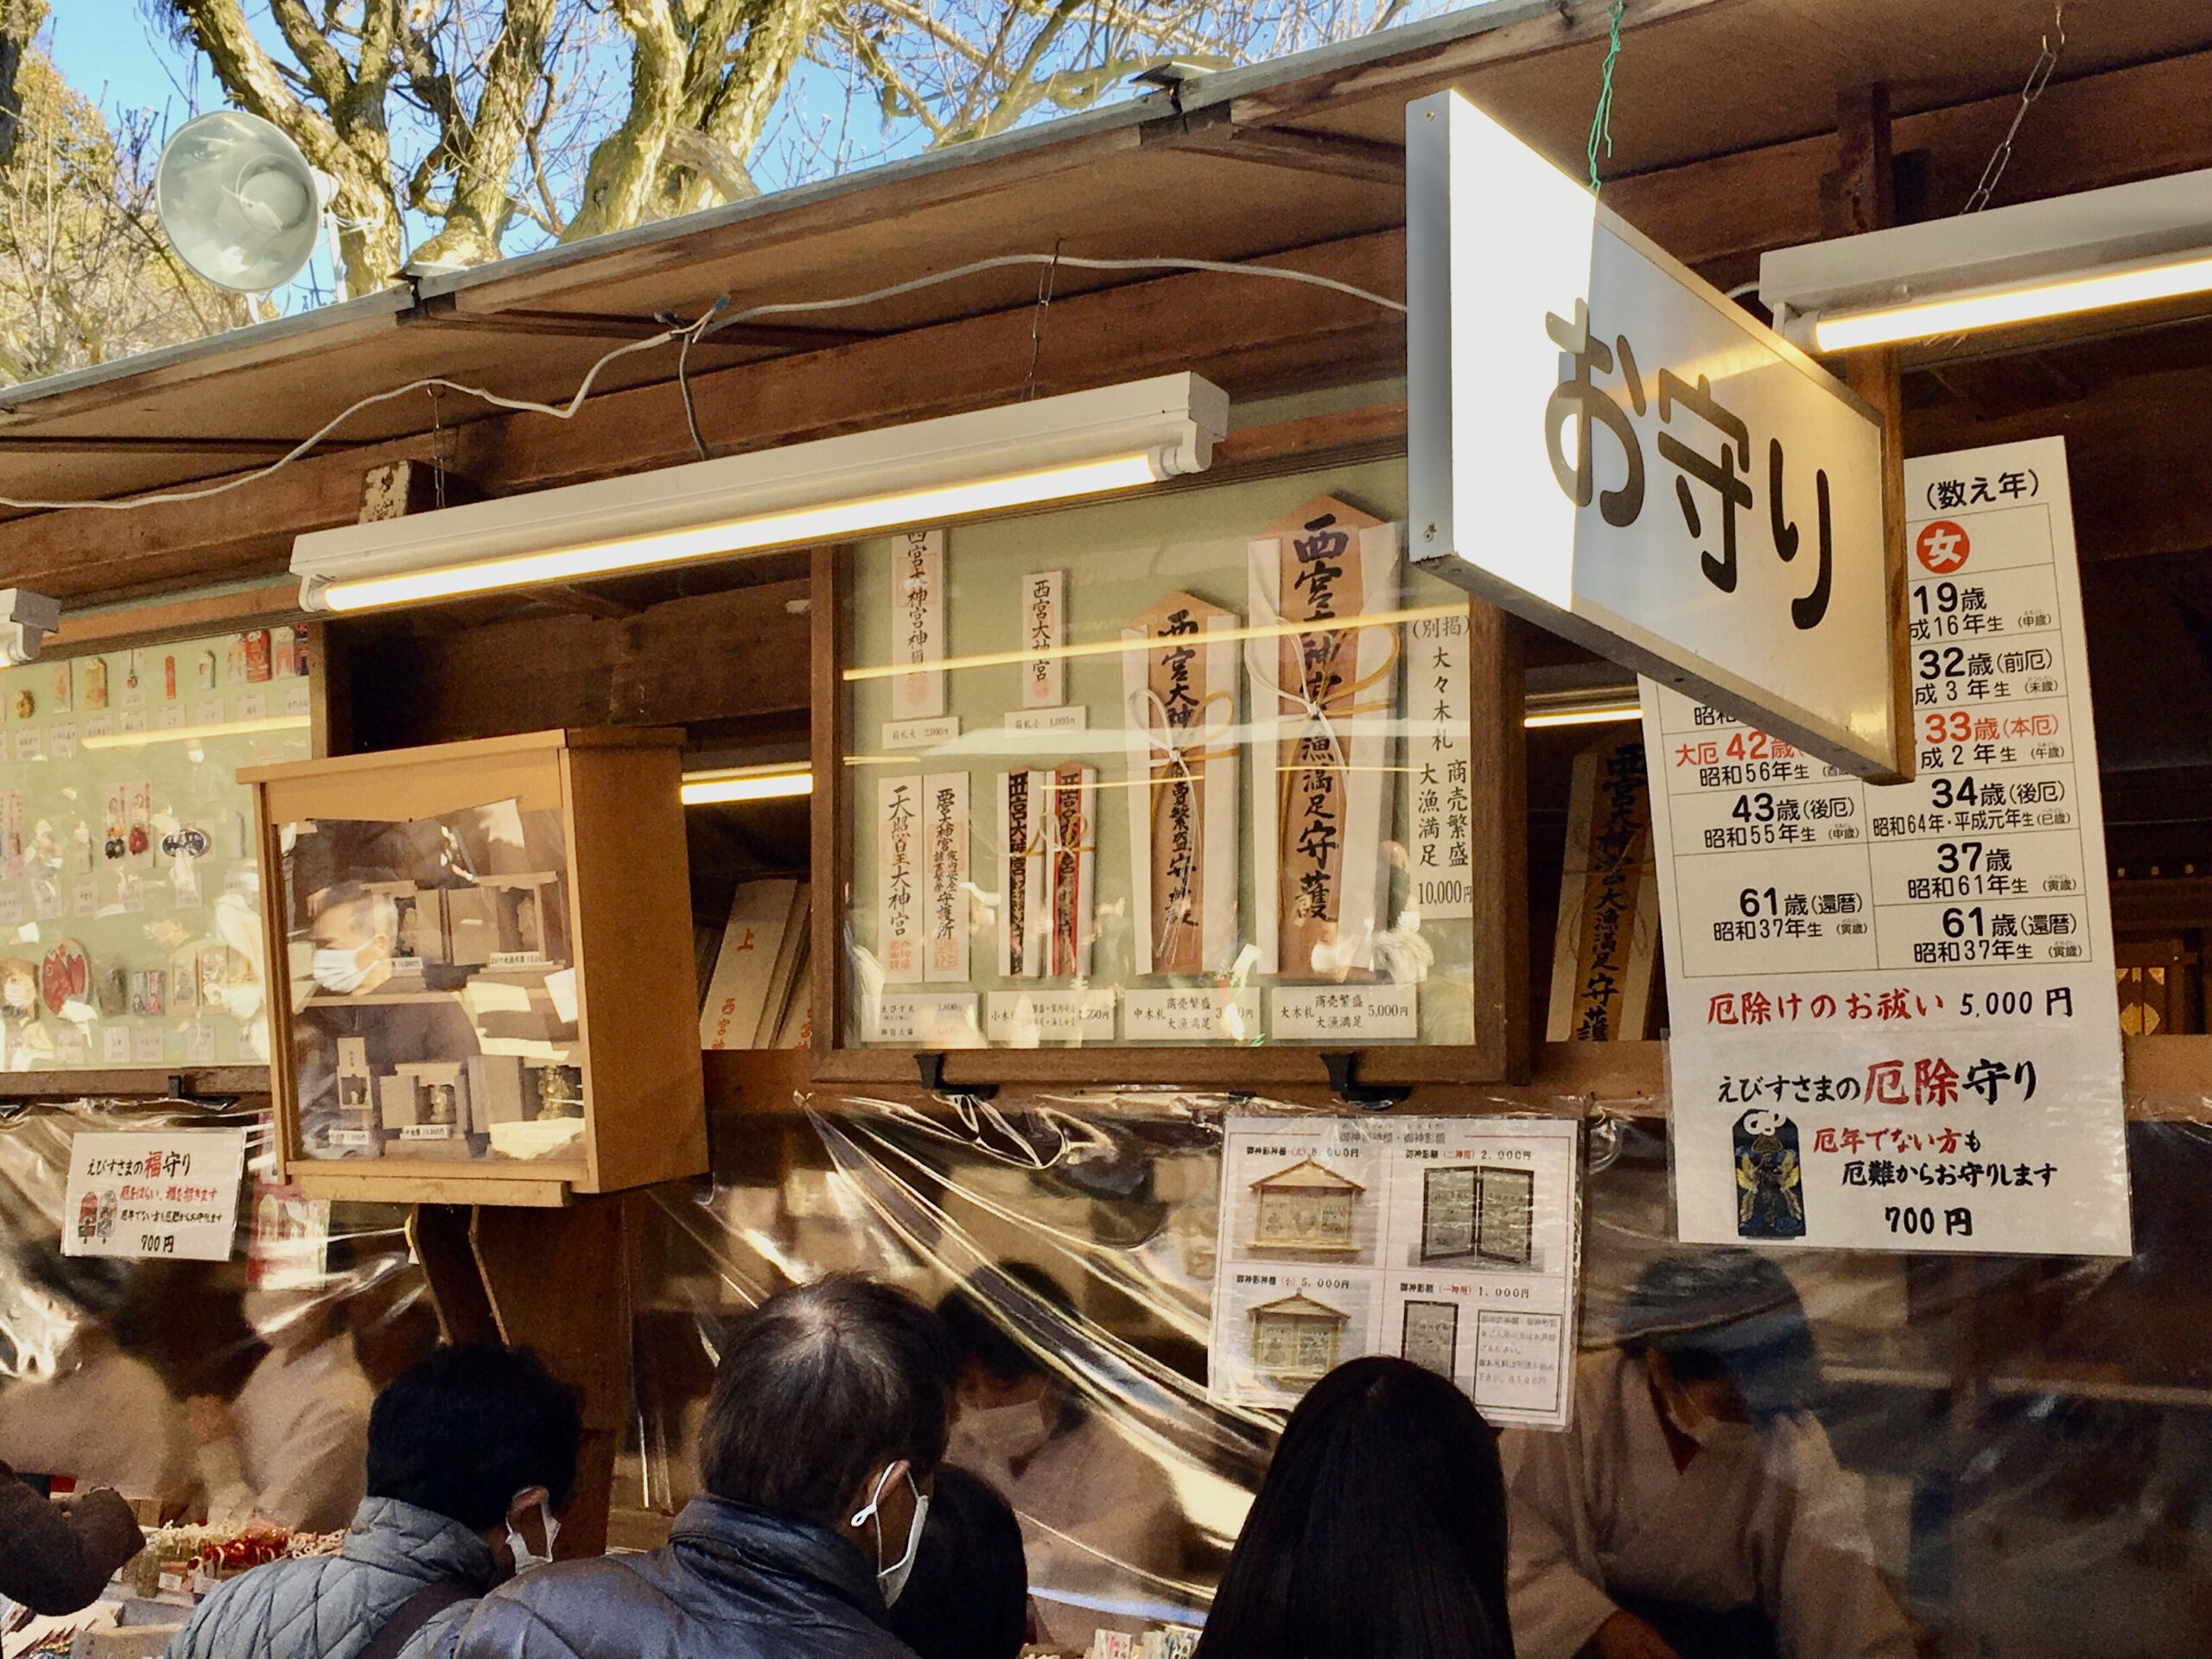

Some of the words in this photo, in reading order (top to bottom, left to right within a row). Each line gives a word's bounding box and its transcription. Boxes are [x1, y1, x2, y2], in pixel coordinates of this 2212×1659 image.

[1546, 296, 1833, 630] お守り
[1927, 469, 2039, 510] (数え年)
[1923, 528, 1964, 568] 女
[1913, 582, 1987, 615] 19歳
[1919, 646, 2053, 680] 32歳(前厄)
[1432, 646, 1453, 751] 大々木札
[1925, 711, 2059, 744] 33歳(本厄)
[1675, 741, 1719, 767] 大厄
[1700, 761, 1809, 786] 昭和56年生
[1732, 792, 1855, 823] 43歳(後厄)
[1931, 776, 2066, 808] 34歳(後厄)
[1418, 762, 1440, 868] 大漁満足
[1447, 760, 1468, 868] 商売繁盛
[1705, 823, 1816, 849] 昭和55年生
[1937, 842, 2012, 874] 37歳
[1418, 880, 1473, 906] 10,000円
[1739, 887, 1863, 917] 61歳(還暦)
[1908, 874, 2029, 899] 昭和61年生
[1713, 918, 1823, 941] 昭和37年生
[1943, 906, 2077, 938] 61歳(還暦)
[1914, 939, 2033, 963] 昭和37年生
[1368, 1004, 1408, 1018] 5,000円
[1707, 988, 1945, 1027] 厄除けのお祓い
[1717, 1057, 2038, 1107] えびすさまの厄除守り
[1814, 1127, 1981, 1154] 厄年でない方も
[1840, 1160, 2057, 1187] 厄難からお守りします
[1885, 1205, 1973, 1236] 700円
[141, 1234, 175, 1254] 700円
